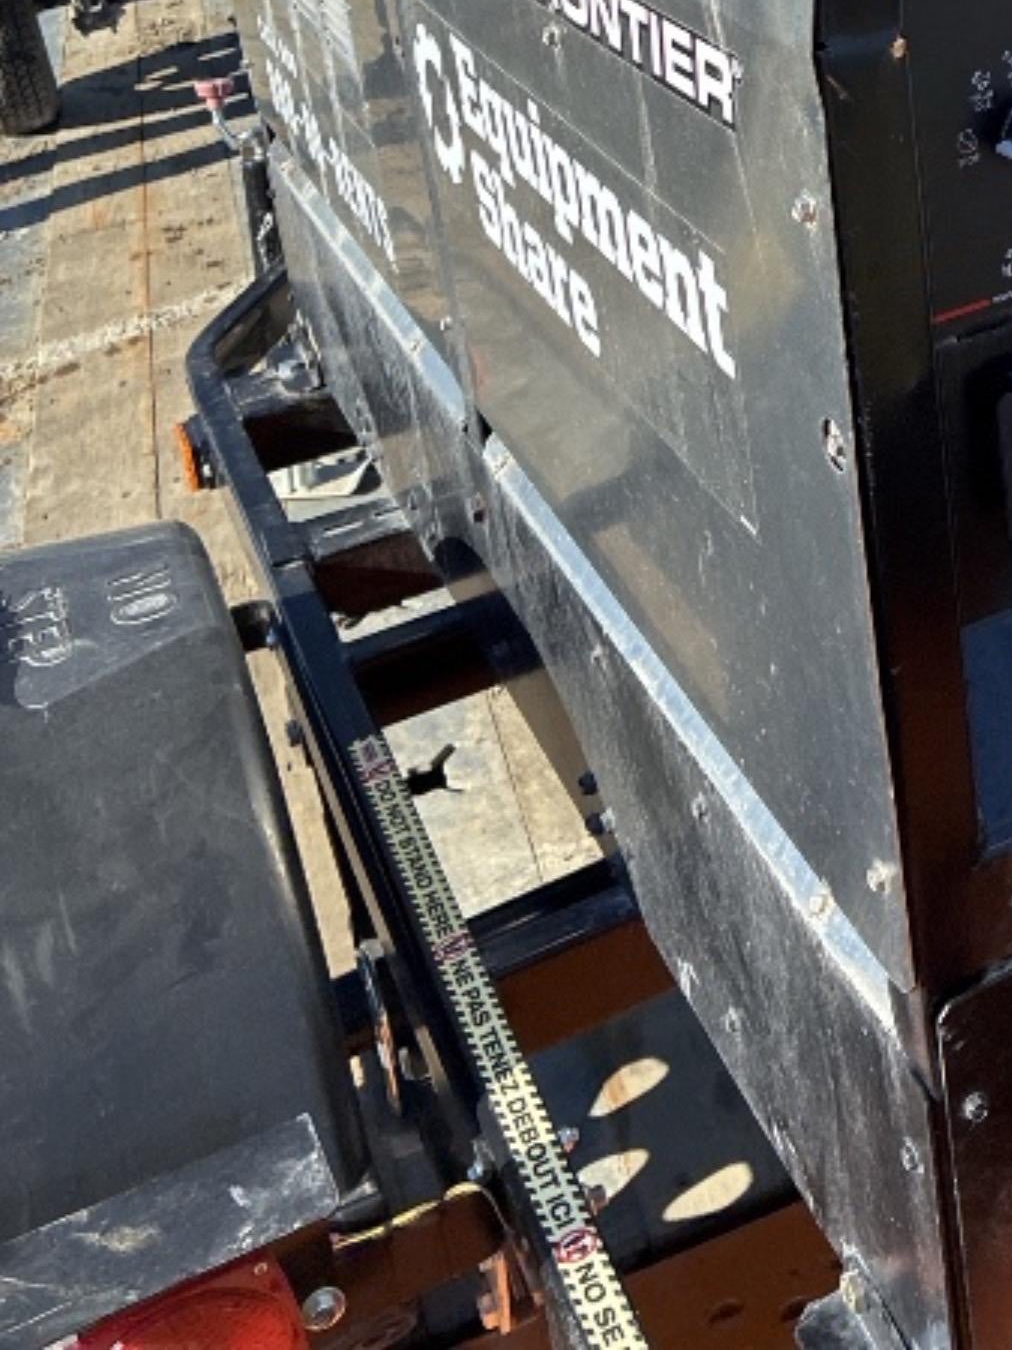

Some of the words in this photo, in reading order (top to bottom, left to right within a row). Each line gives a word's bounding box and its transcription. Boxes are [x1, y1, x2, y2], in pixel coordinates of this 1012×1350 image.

[450, 32, 736, 380] Equipment
[471, 150, 601, 358] Share
[375, 778, 397, 802] DO
[386, 802, 411, 835] NOT
[398, 835, 433, 890] STAND
[422, 889, 455, 939] HERE
[452, 958, 475, 989] NE
[461, 987, 491, 1028] PAS
[479, 1026, 520, 1097] TENEZ
[506, 1097, 561, 1196] DEBOUT
[546, 1192, 577, 1230] ICI
[574, 1261, 606, 1303] NO
[593, 1306, 625, 1348] SE
